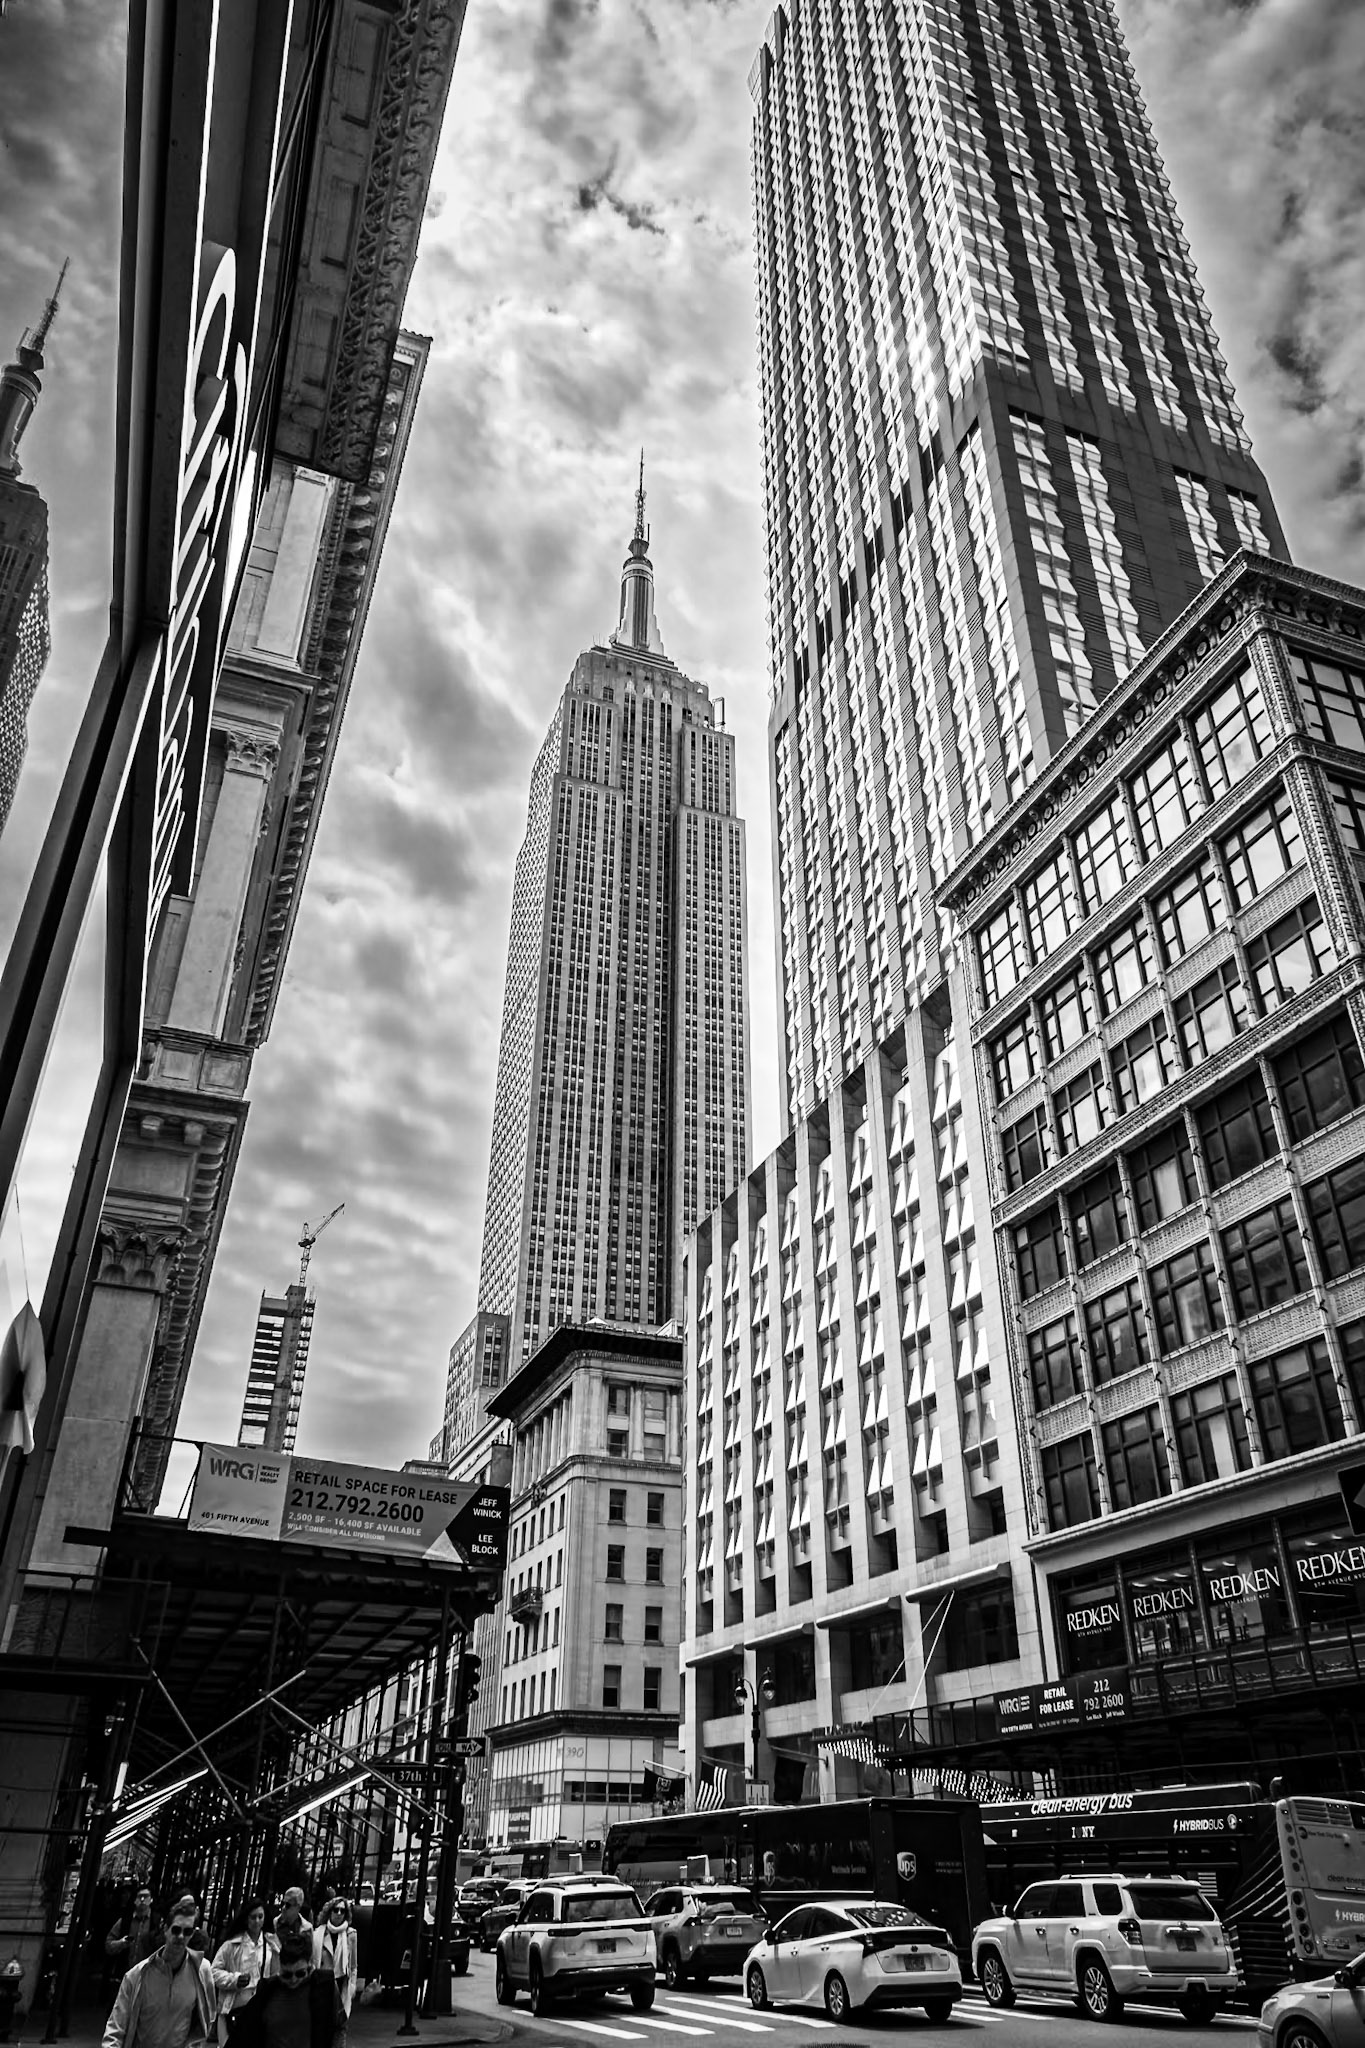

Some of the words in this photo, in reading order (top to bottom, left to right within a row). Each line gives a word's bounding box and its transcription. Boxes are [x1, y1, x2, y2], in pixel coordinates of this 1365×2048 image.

[210, 1458, 254, 1480] WRG
[295, 1471, 341, 1488] RETAIL
[345, 1478, 388, 1494] SPACE
[391, 1485, 416, 1499] FOR
[419, 1489, 458, 1504] LEASE
[291, 1488, 424, 1523] 212.792.2600
[478, 1498, 498, 1508] JEFF
[216, 1513, 238, 1522] FIFTH
[240, 1517, 270, 1526] AVENUE
[473, 1508, 502, 1519] WINICK
[339, 1529, 352, 1537] ALL
[364, 1522, 375, 1530] SF
[376, 1523, 422, 1536] AVAILABLE
[478, 1534, 493, 1543] LEE
[472, 1544, 499, 1555] BLOCK
[1210, 1566, 1280, 1600] REDKEN
[1133, 1585, 1194, 1617] REDKEN
[1067, 1602, 1121, 1632] REDKEN
[1044, 1686, 1067, 1700] RETAIL
[1093, 1678, 1110, 1693] 212
[998, 1697, 1020, 1715] WRG
[1039, 1703, 1053, 1715] FOR
[1053, 1700, 1075, 1713] LEASE
[1083, 1698, 1100, 1711] 792
[1102, 1693, 1124, 1709] 2600
[462, 1743, 478, 1752] WAY
[400, 1770, 422, 1781] 37th
[1031, 1798, 1106, 1815] clean-energy
[1108, 1793, 1133, 1809] bus
[1179, 1818, 1225, 1832] HYBRIDBUS
[900, 1859, 916, 1877] ups
